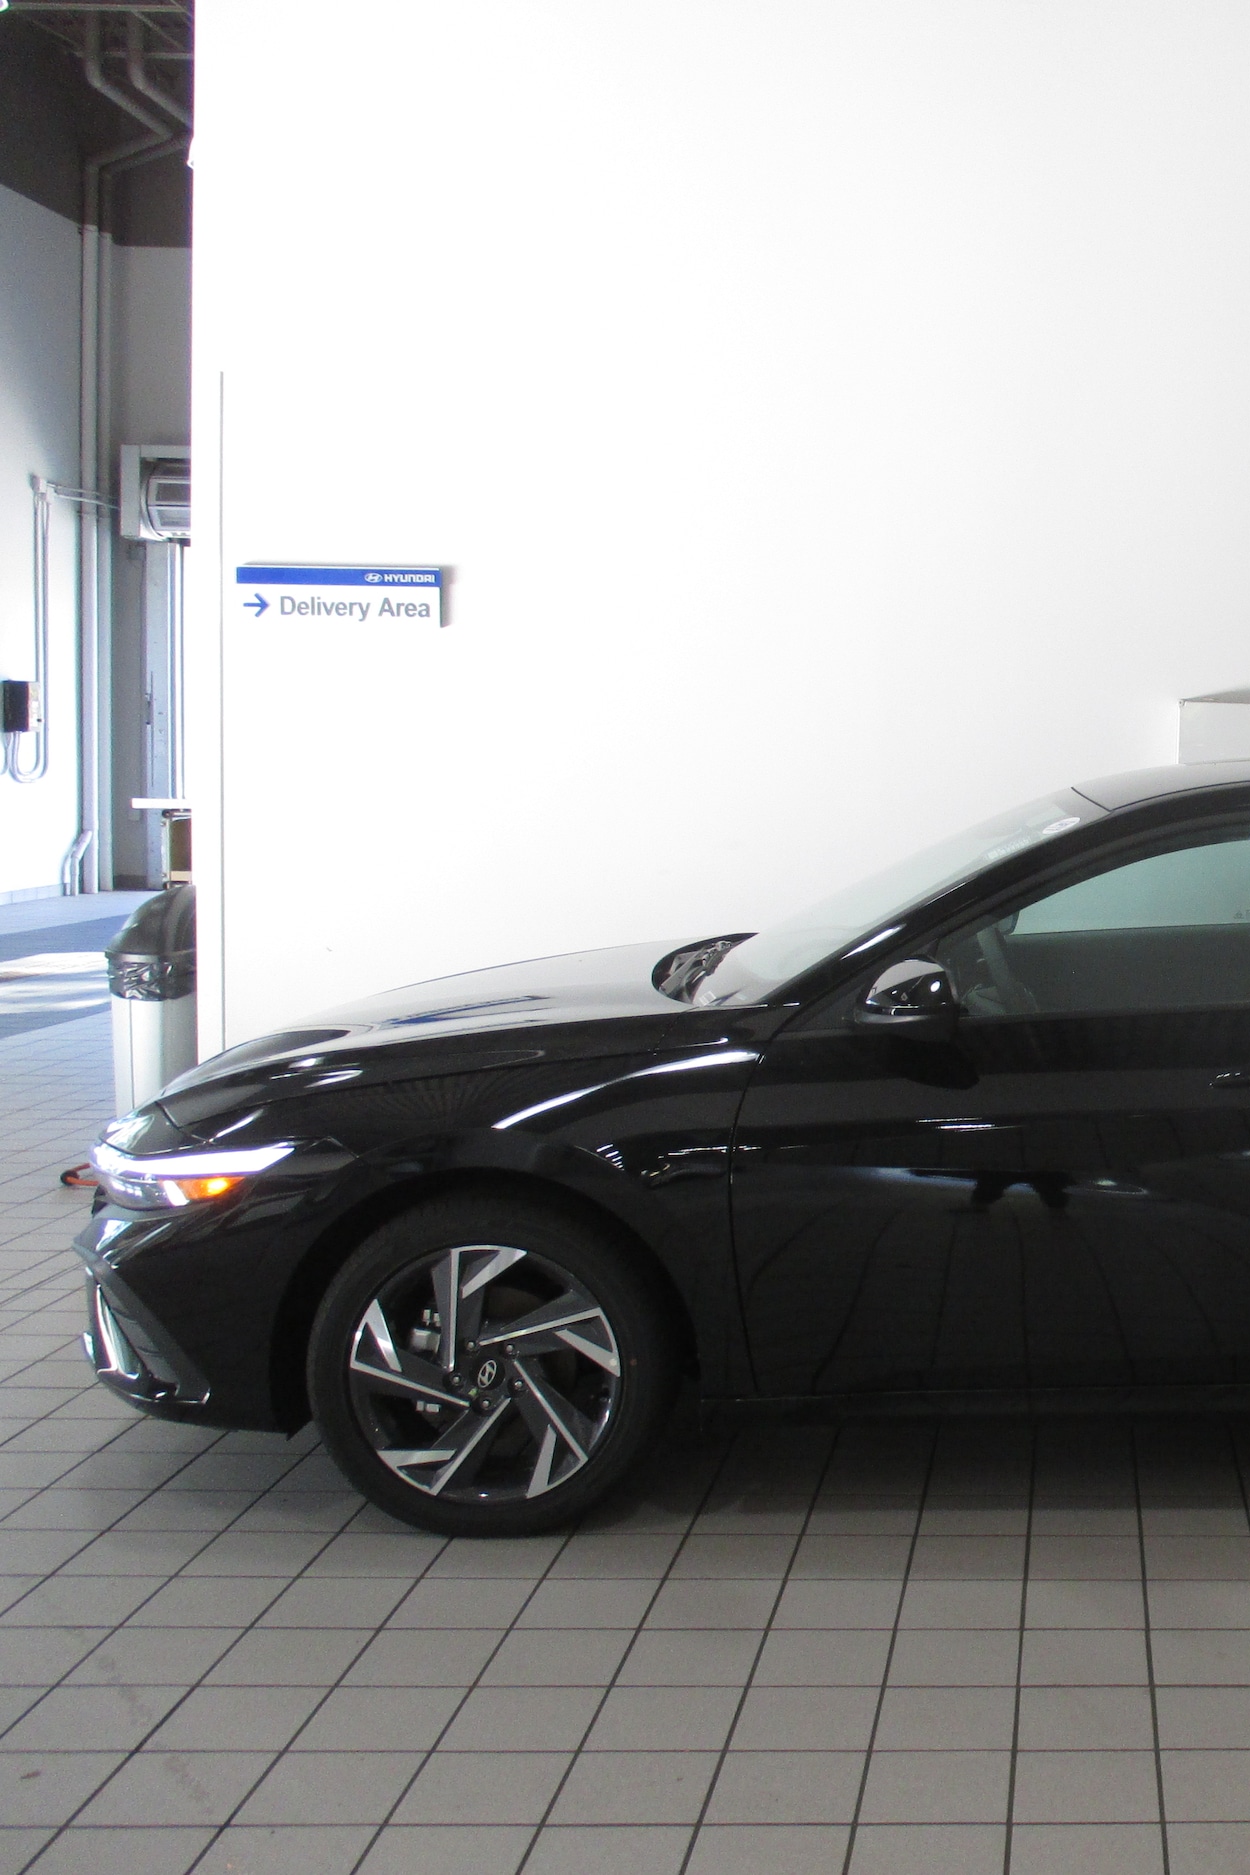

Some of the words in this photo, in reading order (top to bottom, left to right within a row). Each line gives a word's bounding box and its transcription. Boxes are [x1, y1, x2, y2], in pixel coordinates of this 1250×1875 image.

[384, 573, 435, 583] HYUNDAI
[279, 595, 371, 622] Delivery
[378, 597, 431, 618] Area
